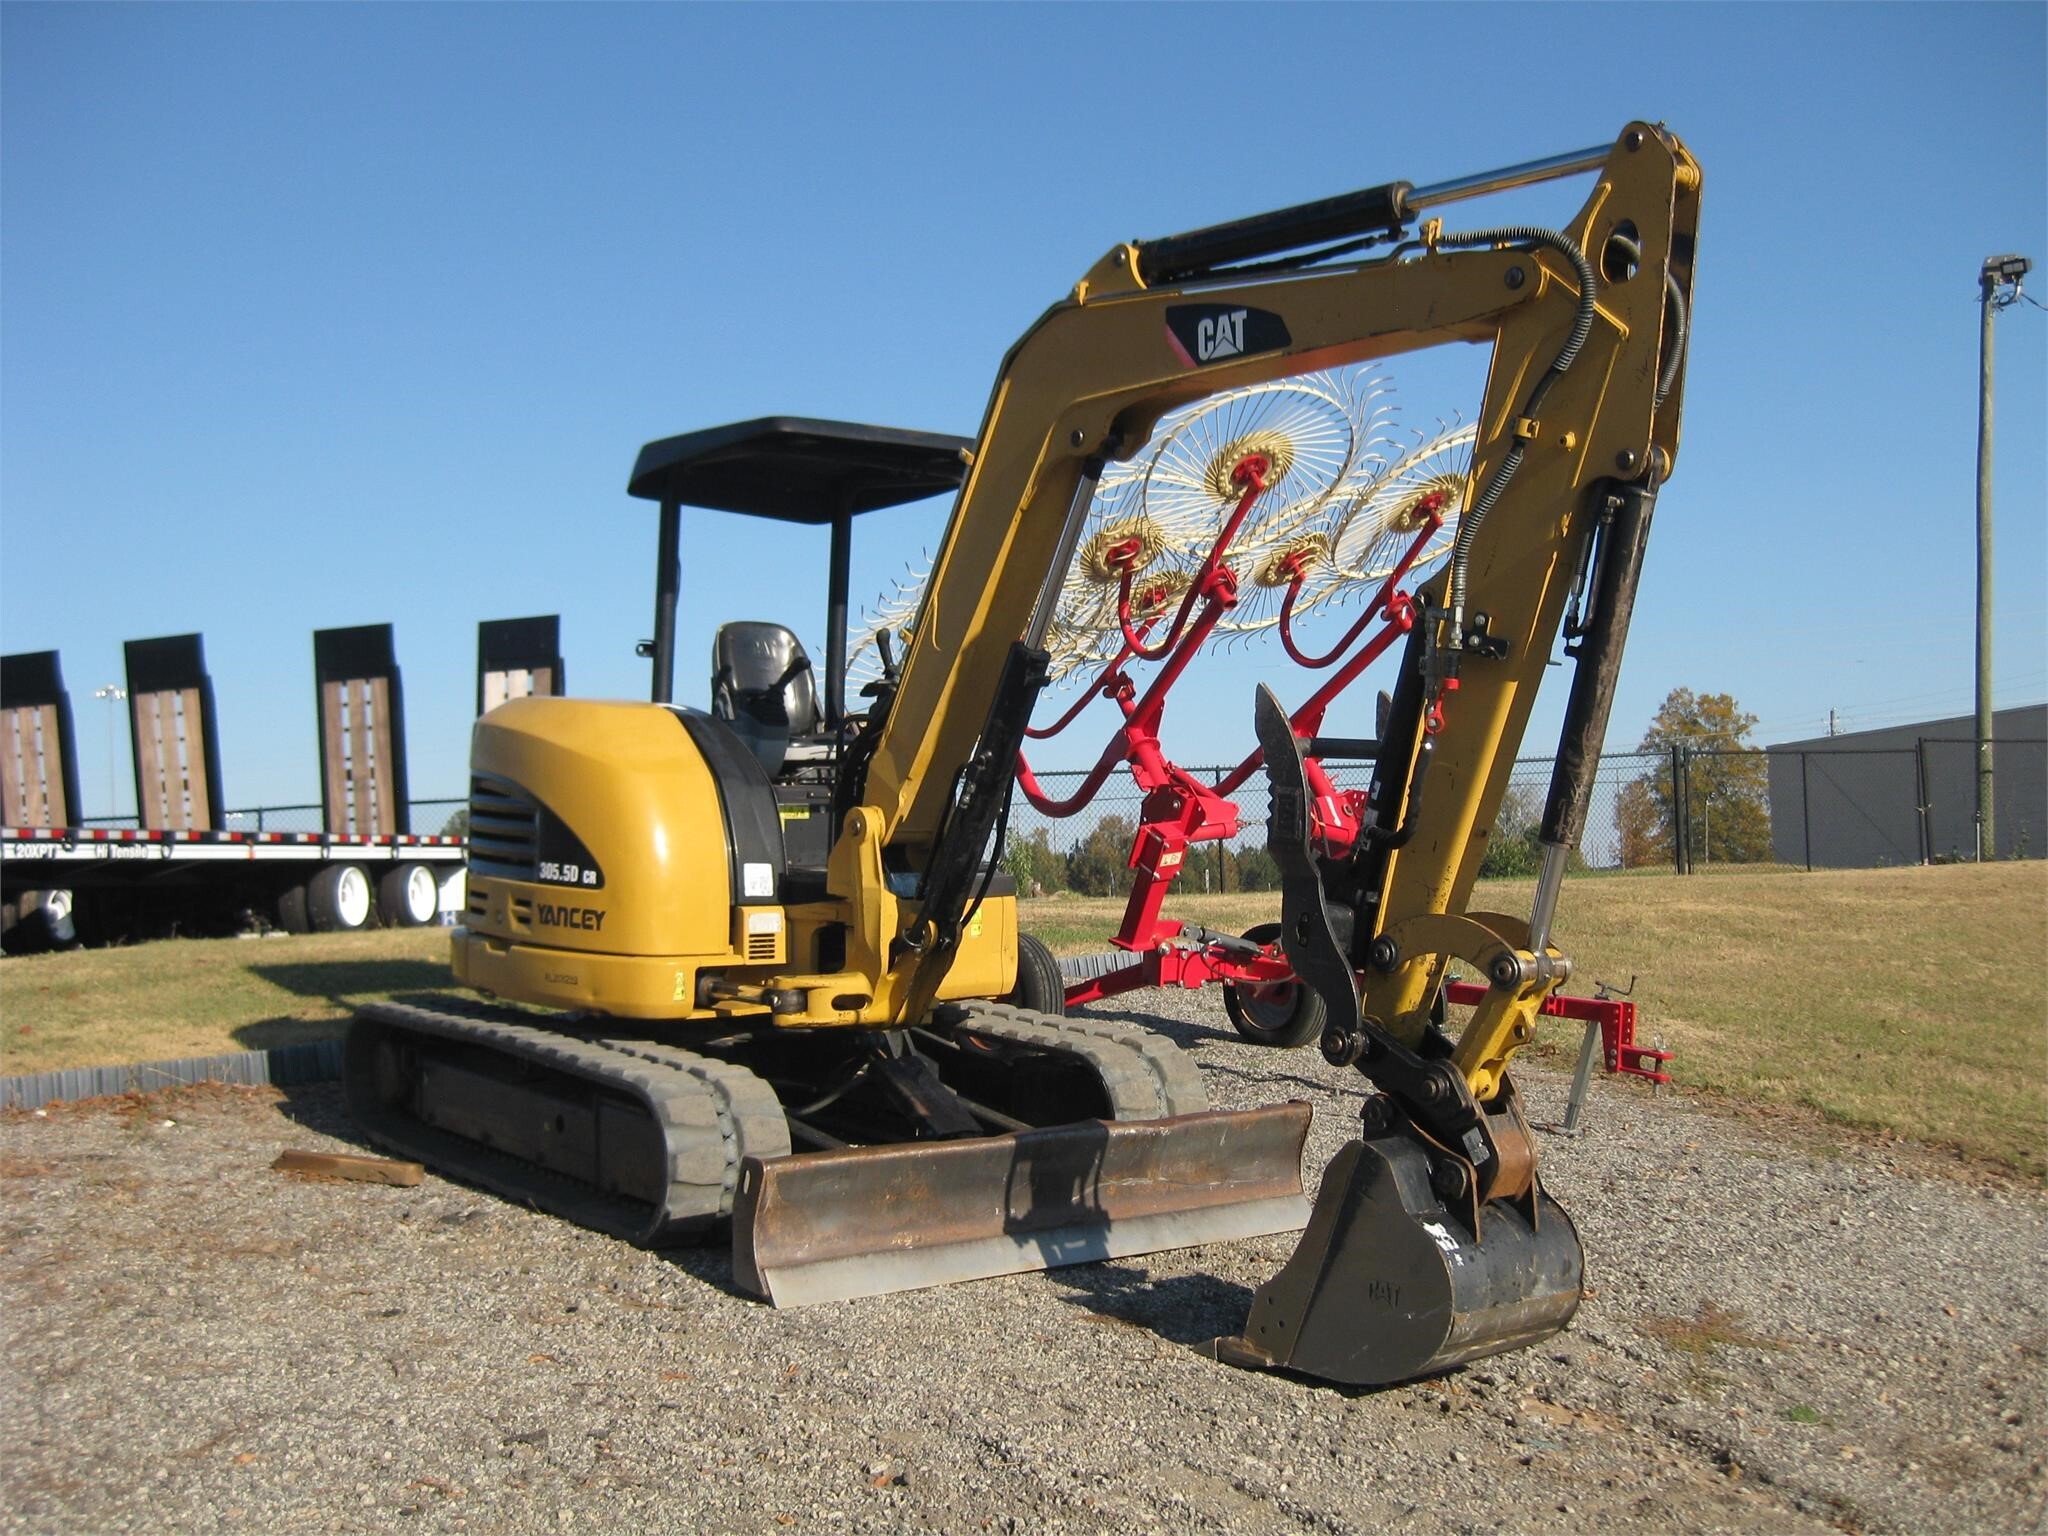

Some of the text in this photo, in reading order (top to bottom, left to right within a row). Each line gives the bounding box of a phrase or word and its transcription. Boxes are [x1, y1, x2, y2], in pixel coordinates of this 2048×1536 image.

[1198, 310, 1248, 361] CAT
[539, 862, 597, 884] 305.5D CR
[537, 903, 606, 931] YANCEY
